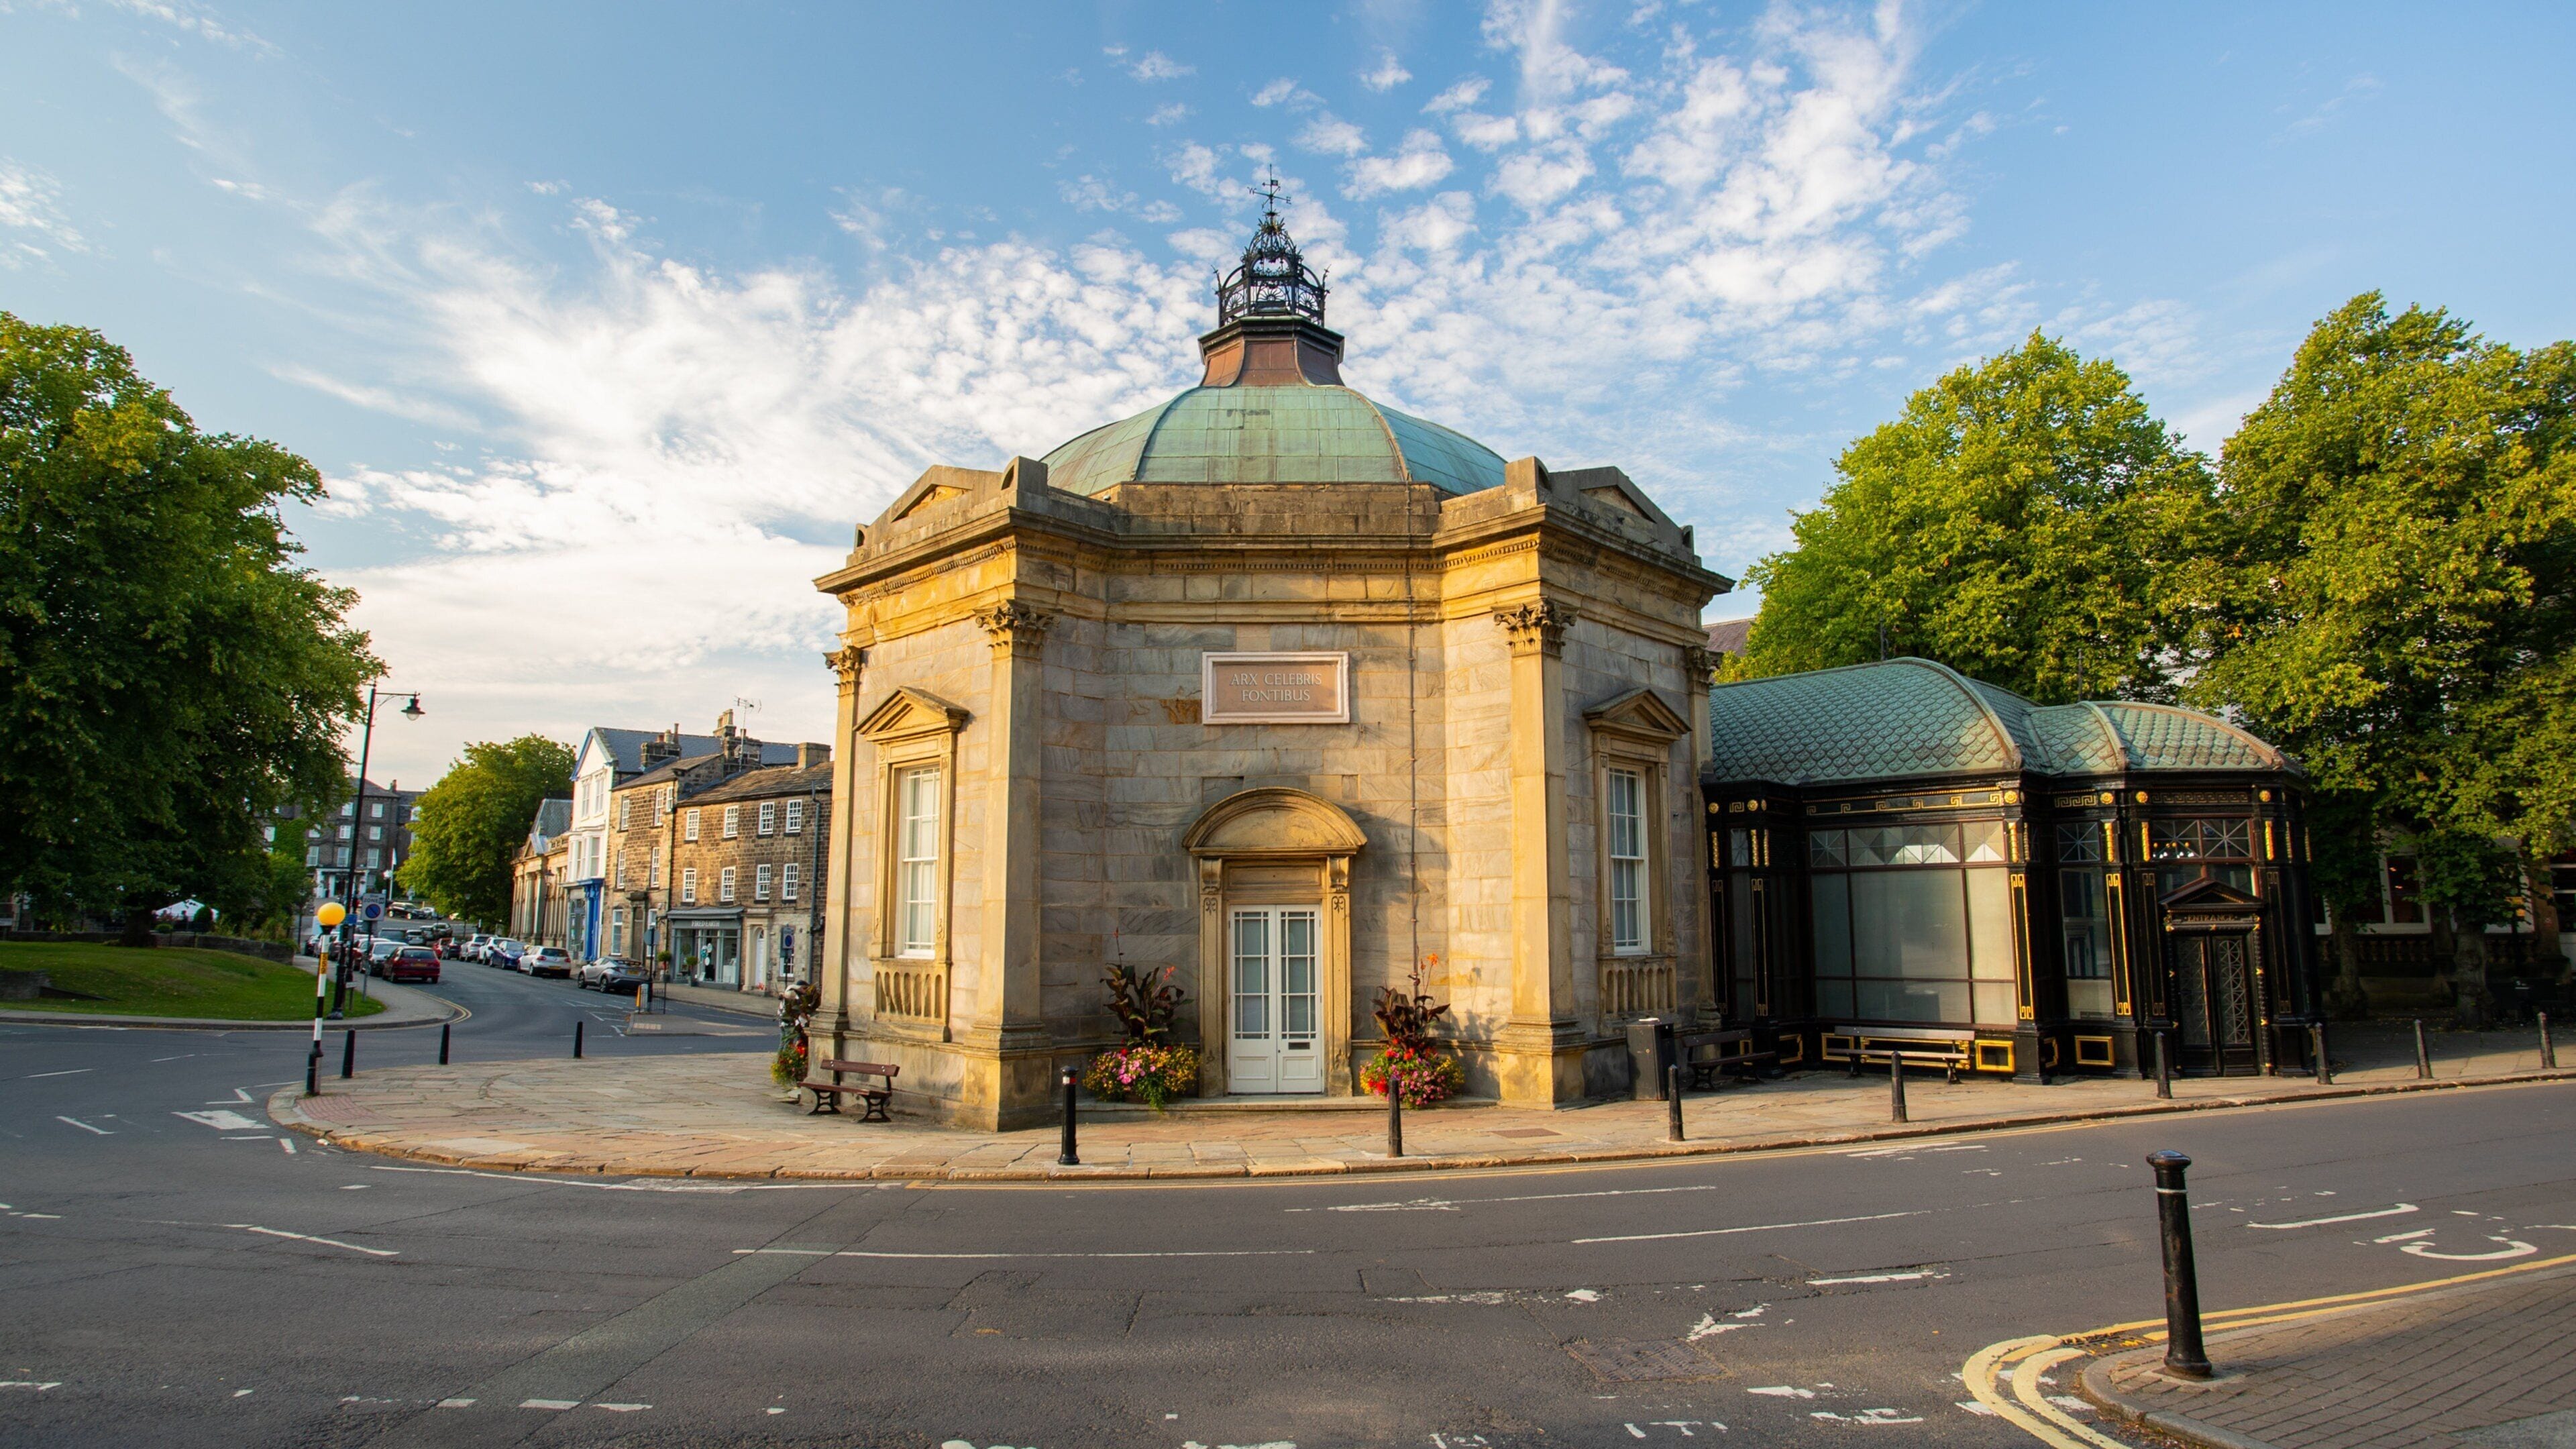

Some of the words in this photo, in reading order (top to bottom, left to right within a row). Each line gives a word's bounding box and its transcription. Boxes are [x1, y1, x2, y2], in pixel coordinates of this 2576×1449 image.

[1230, 673, 1258, 686] ARX
[1264, 673, 1322, 686] CELEBRIS
[1242, 689, 1311, 702] FONTIBUS
[2188, 914, 2235, 922] ENTRANCE
